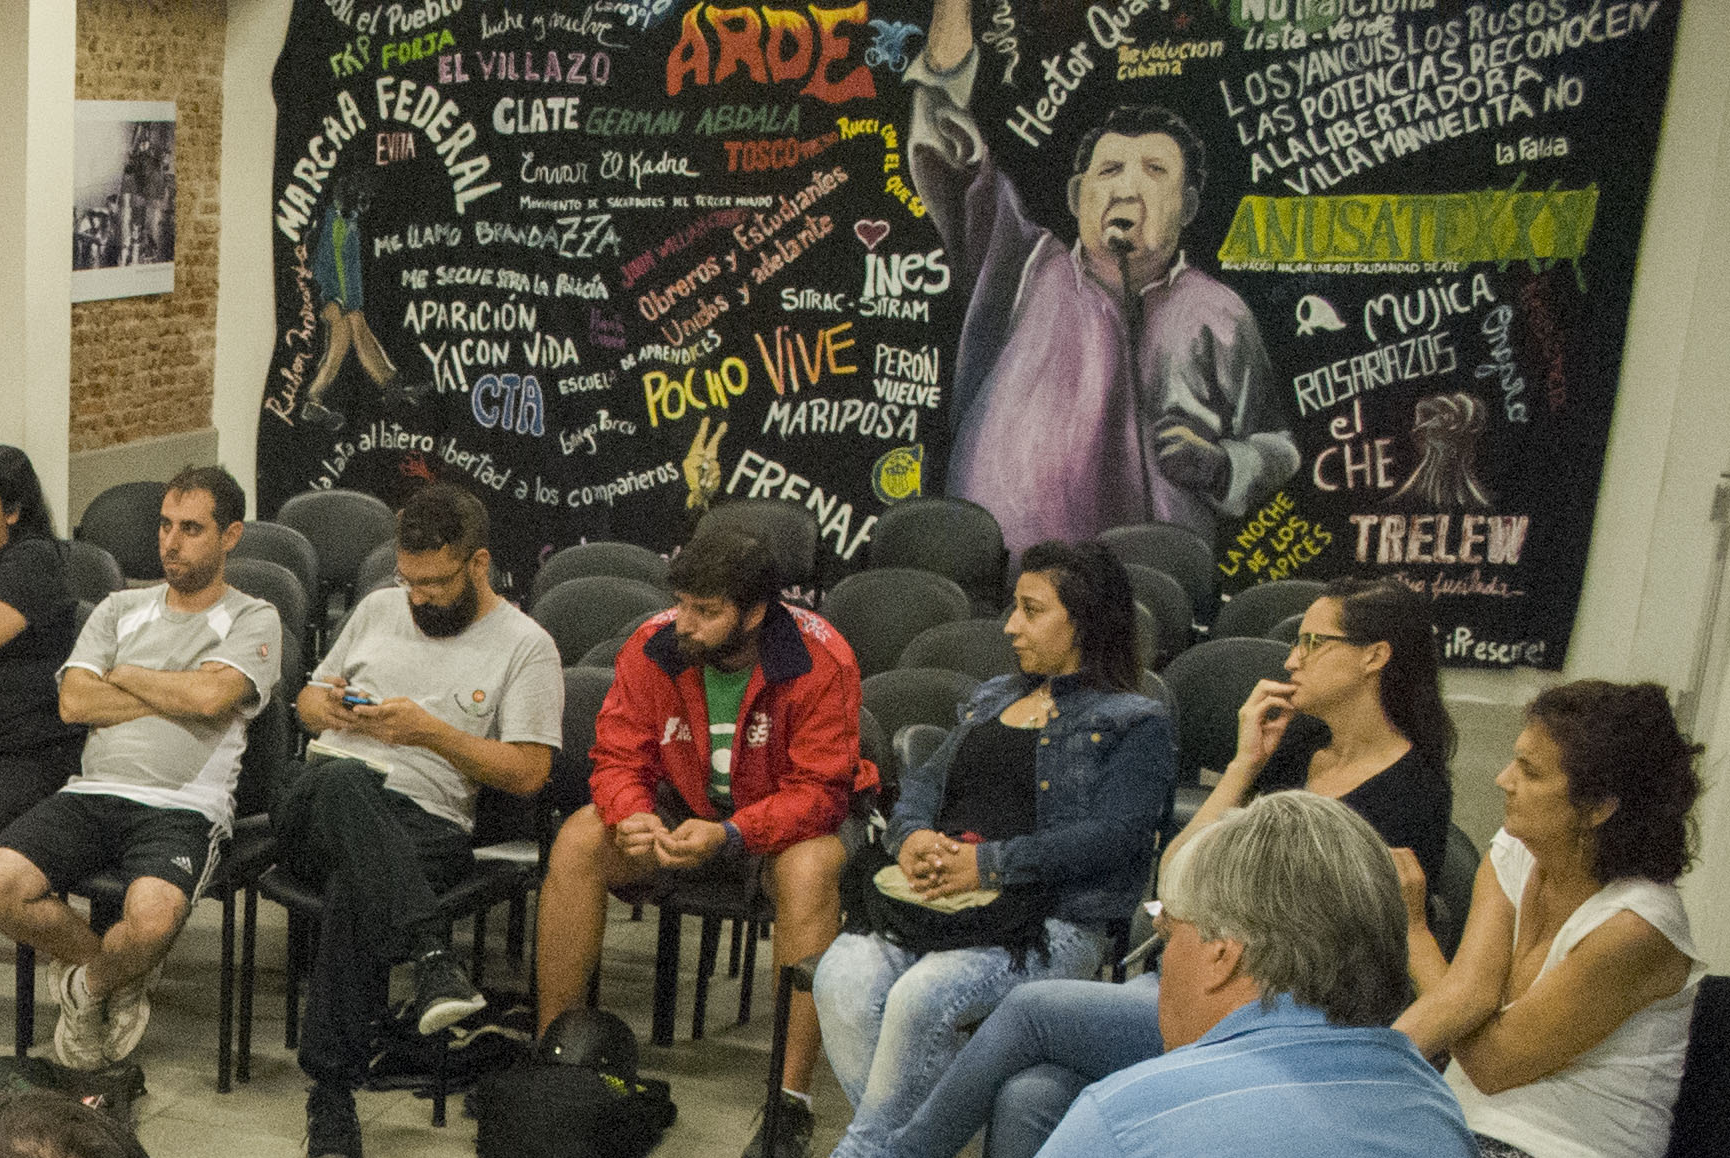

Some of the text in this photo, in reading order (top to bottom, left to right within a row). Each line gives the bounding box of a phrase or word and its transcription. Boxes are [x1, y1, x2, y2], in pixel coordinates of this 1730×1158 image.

[381, 29, 456, 70] FORJA
[666, 0, 877, 103] ARDE
[1243, 21, 1307, 50] Lista
[438, 49, 610, 86] EL VILLAZO
[1220, 64, 1291, 118] LOS
[1407, 20, 1462, 56] LOS
[1466, 1, 1567, 40] RUSOS
[1237, 2, 1659, 147] LAS POTENCIAS RECONOCEN
[492, 97, 581, 135] CLATE
[1006, 41, 1094, 148] Hector
[586, 104, 802, 137] GERMAN ABDALA
[1283, 74, 1584, 195] VILLA MANUELITA NO
[375, 75, 503, 215] FEDERAL
[375, 132, 416, 166] EVITA
[723, 138, 799, 172] TOSCO
[885, 175, 911, 202] QUE
[373, 235, 403, 258] ME
[637, 255, 722, 320] Obreros
[733, 165, 849, 251] Estudiantes
[401, 269, 429, 290] ME
[781, 287, 846, 313] SITRAC
[858, 297, 930, 323] SITRAM
[460, 338, 510, 367] CON
[471, 373, 546, 438] CTA
[641, 356, 749, 428] POCHO
[873, 378, 941, 409] VUELVE
[762, 398, 919, 442] MARIPOSA
[1329, 400, 1363, 439] el
[514, 480, 529, 500] a
[534, 476, 560, 506] los
[567, 462, 680, 508] compañeros
[1313, 439, 1395, 492] CHE
[1218, 491, 1296, 577] LA NOCHE
[1246, 515, 1310, 574] DE LOS
[1256, 523, 1333, 583] APICES
[1349, 514, 1530, 566] TRELEW
